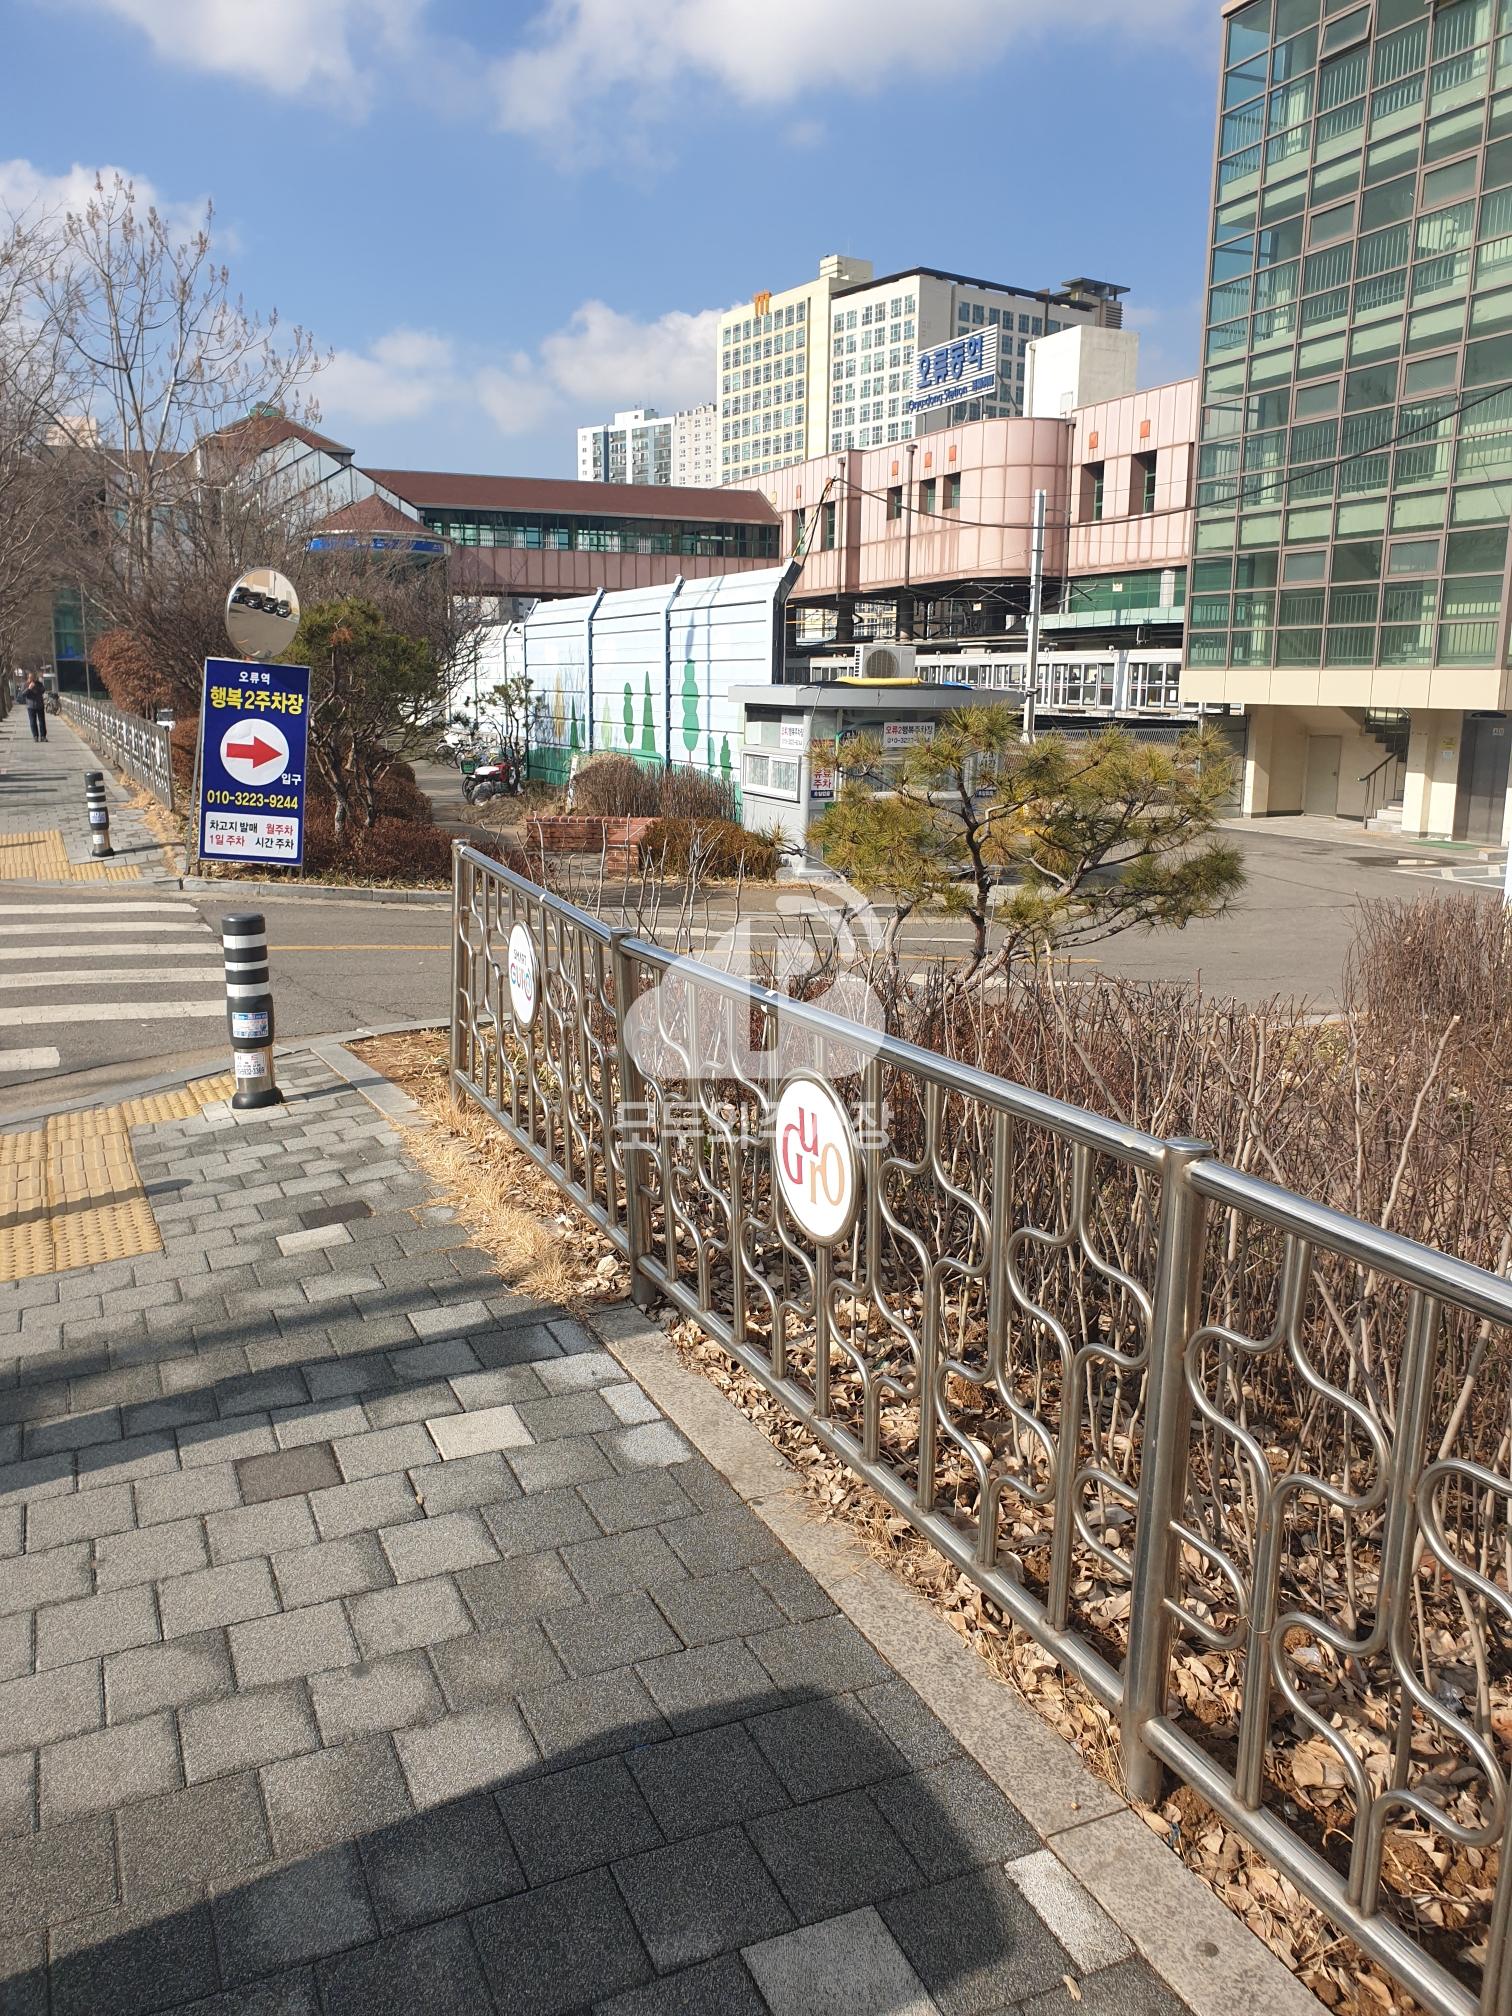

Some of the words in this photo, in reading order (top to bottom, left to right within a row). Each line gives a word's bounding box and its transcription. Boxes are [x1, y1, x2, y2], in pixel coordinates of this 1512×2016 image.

[917, 335, 985, 389] 오류동역
[239, 671, 270, 685] 오류역
[210, 686, 304, 715] 행복2주차장
[281, 773, 302, 786] 입구
[813, 779, 832, 788] 주차
[207, 789, 298, 809] 010-3223-9244
[209, 819, 238, 832] 차고지
[240, 822, 258, 834] 발매
[265, 823, 294, 836] 월주차
[209, 834, 224, 846] 1일
[226, 835, 245, 847] 주차
[255, 836, 274, 849] 시간
[275, 838, 294, 850] 주차
